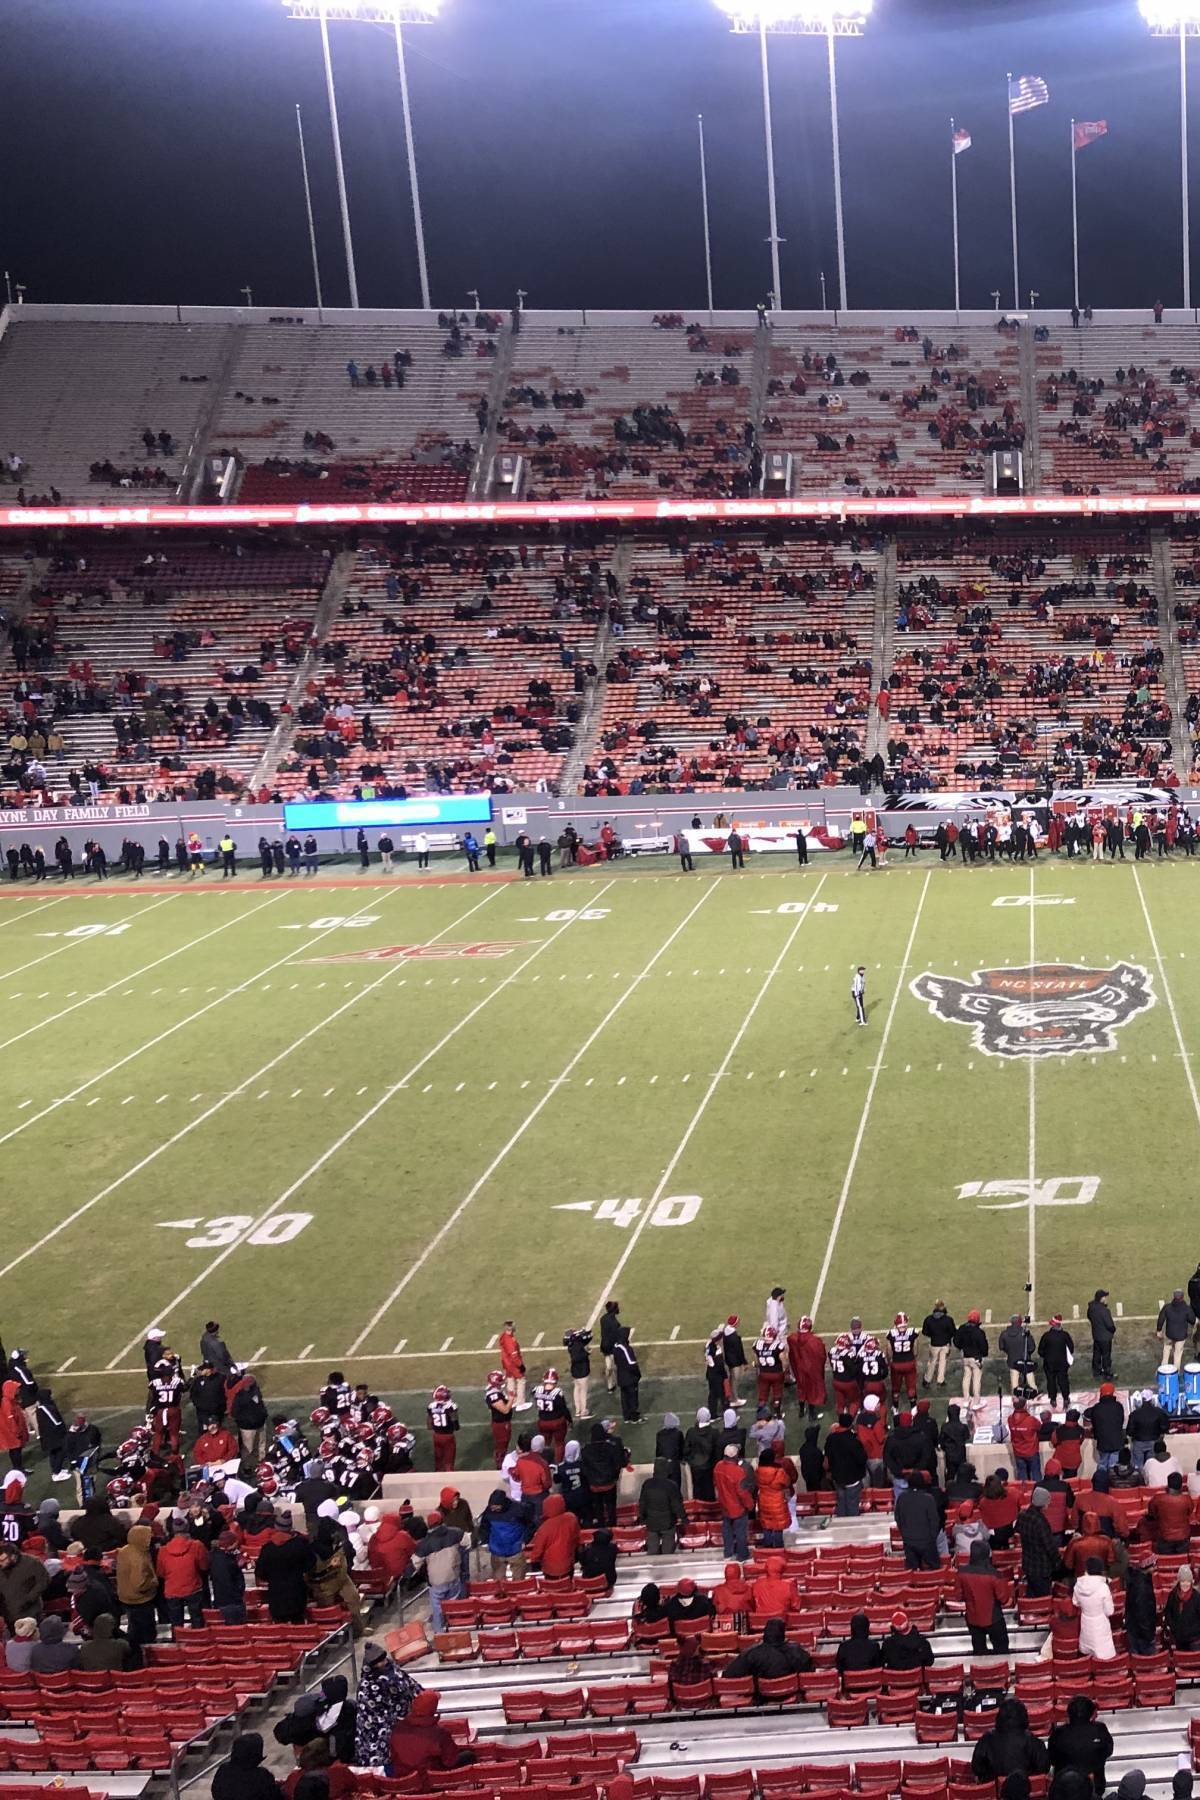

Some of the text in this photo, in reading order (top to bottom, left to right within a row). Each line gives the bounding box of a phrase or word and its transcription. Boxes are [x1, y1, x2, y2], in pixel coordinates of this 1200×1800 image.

[33, 809, 60, 822] DAY
[64, 806, 110, 820] FAMILY
[115, 804, 150, 818] FIELD
[284, 939, 544, 965] ACC
[999, 978, 1088, 990] NC STATE
[592, 1195, 703, 1227] 40
[185, 1212, 314, 1248] 30
[894, 1341, 911, 1353] 52
[862, 1361, 879, 1376] 43
[158, 1390, 174, 1403] 31
[536, 1399, 553, 1411] 93
[432, 1413, 447, 1427] 21
[340, 1472, 359, 1488] 47
[569, 1475, 581, 1490] 3
